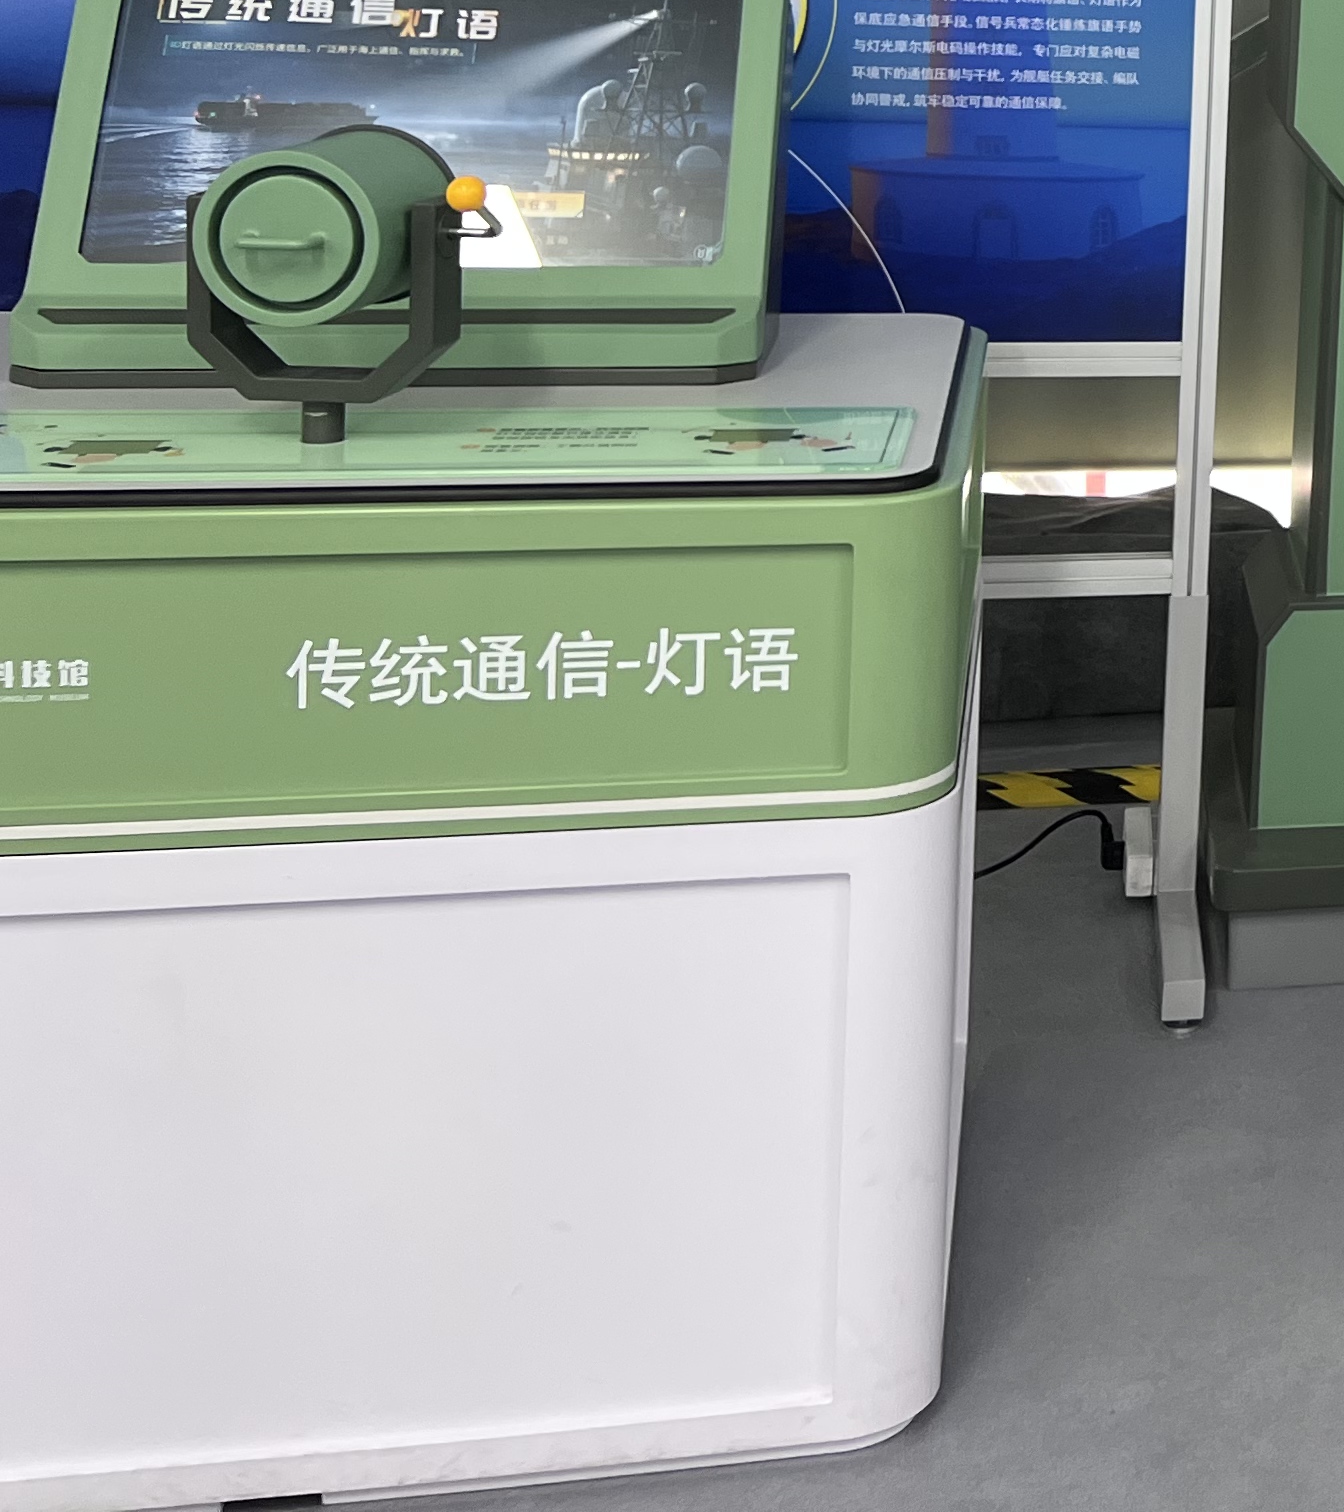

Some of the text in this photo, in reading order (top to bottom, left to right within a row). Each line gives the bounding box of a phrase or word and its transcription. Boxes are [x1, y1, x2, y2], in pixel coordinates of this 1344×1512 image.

[286, 627, 800, 710] 传统通信-灯语
